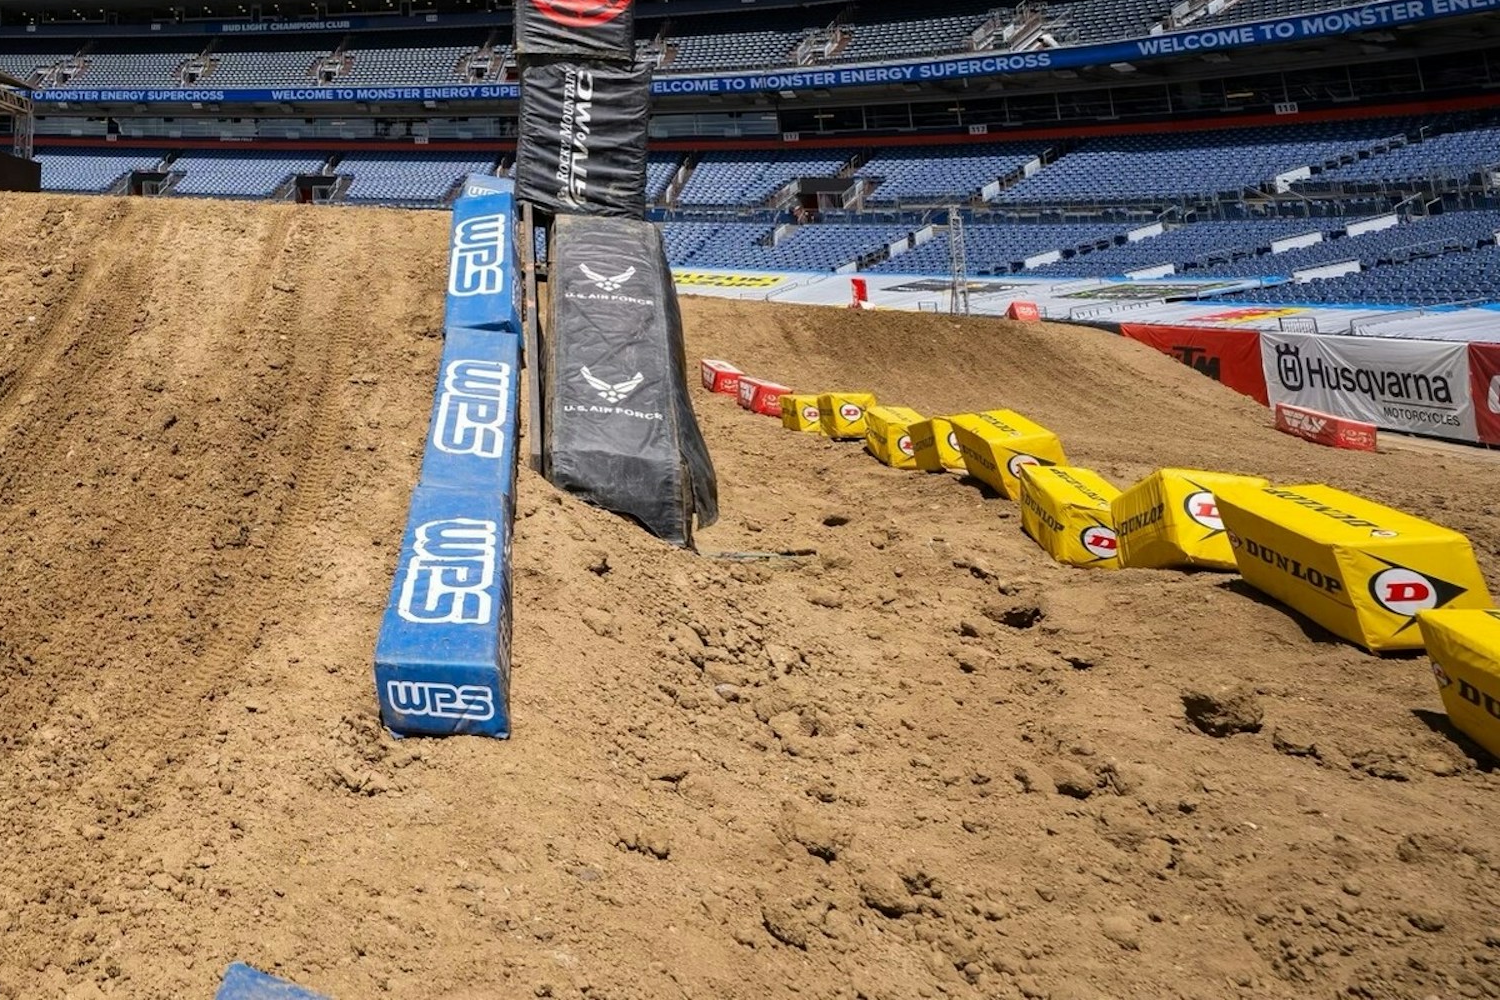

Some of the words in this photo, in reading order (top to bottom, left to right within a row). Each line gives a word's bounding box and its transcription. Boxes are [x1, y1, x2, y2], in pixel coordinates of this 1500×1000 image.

[222, 24, 241, 32] BUD
[242, 23, 267, 31] LIGHT
[270, 21, 325, 31] CHAMPIONS
[325, 20, 350, 29] CLUB
[1137, 26, 1255, 56] WELCOME
[1259, 20, 1295, 40] TO
[1301, 0, 1425, 35] MONSTER
[722, 76, 744, 90] TO
[751, 71, 836, 90] MONSTER
[841, 65, 915, 84] ENERGY
[919, 52, 1051, 78] SUPERCROSS
[45, 90, 98, 101] MONSTER
[101, 90, 147, 101] ENERGY
[147, 90, 224, 101] SUPERCROSS
[271, 89, 334, 100] WELCOME
[335, 89, 354, 99] TO
[356, 88, 420, 99] MONSTER
[423, 87, 478, 98] ENERGY
[481, 86, 520, 97] SUPE
[560, 68, 578, 139] MOUNTAIN
[1278, 103, 1296, 112] 118
[556, 142, 572, 184] ROCKY
[611, 295, 654, 306] FORCE
[1172, 346, 1221, 381] TM
[1306, 356, 1453, 403] Husqvarna
[564, 405, 588, 413] U.S.
[589, 405, 613, 414] AIR
[616, 407, 663, 420] FORCE
[1383, 406, 1461, 427] MOTORCYCLES
[1024, 493, 1065, 533] DUNLOP
[1120, 503, 1165, 537] DUNLOP
[1246, 538, 1343, 595] DUNLOP
[1385, 582, 1429, 602] D
[387, 681, 495, 721] WPS
